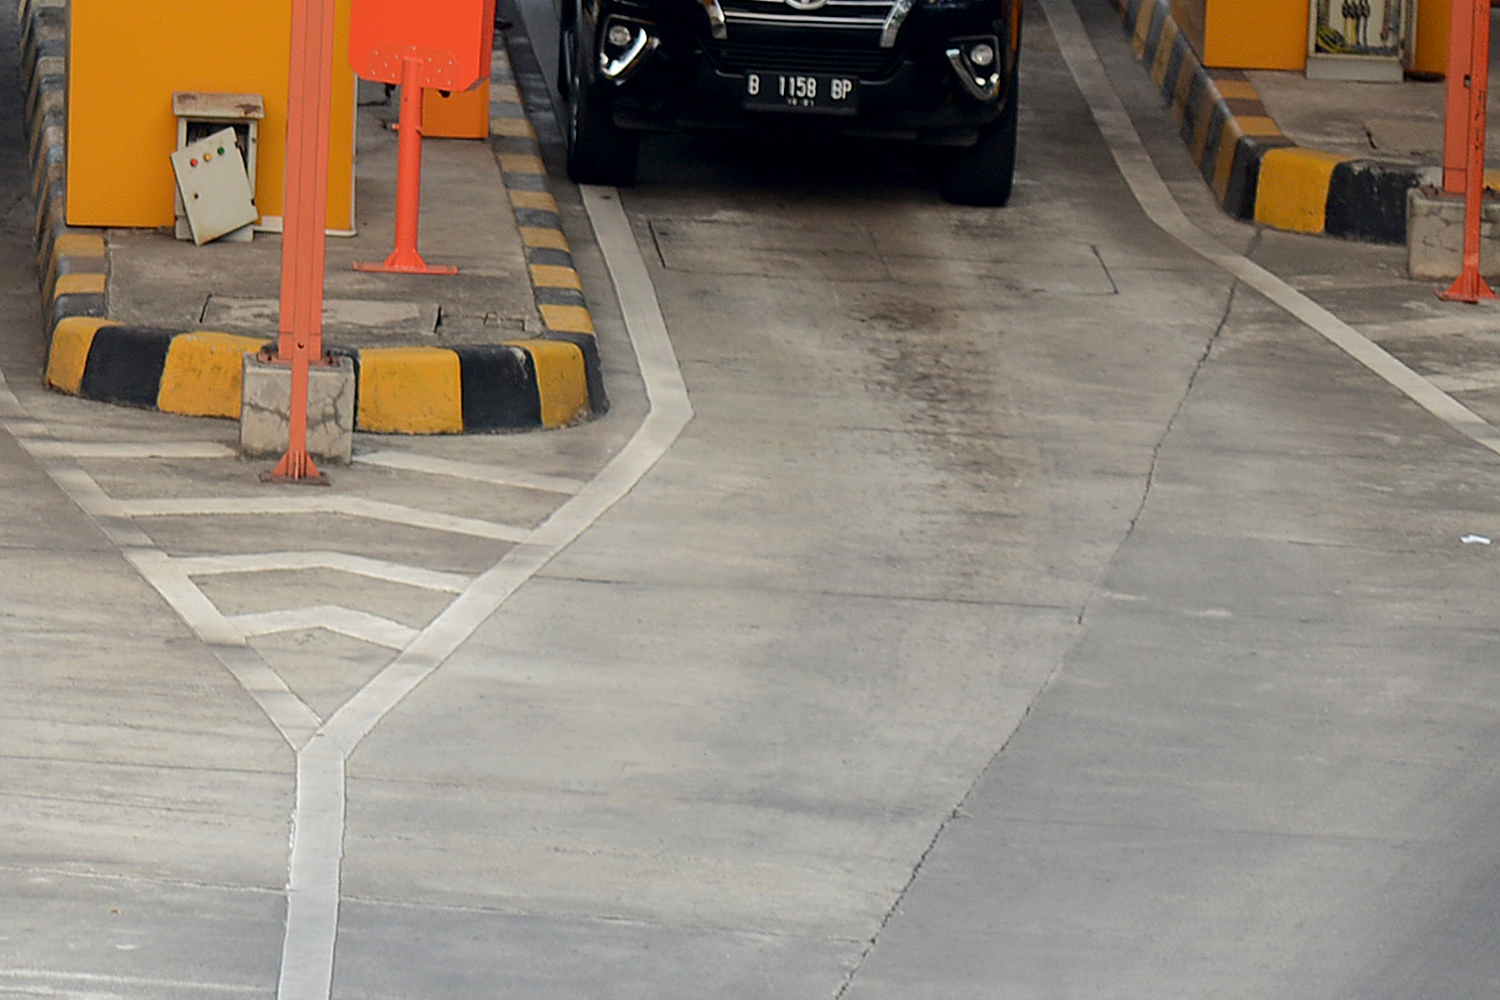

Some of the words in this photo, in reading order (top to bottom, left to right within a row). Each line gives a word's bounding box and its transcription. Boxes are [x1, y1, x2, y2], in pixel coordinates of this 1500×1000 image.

[748, 74, 760, 95] B
[779, 76, 817, 98] 1158
[831, 79, 853, 100] BP
